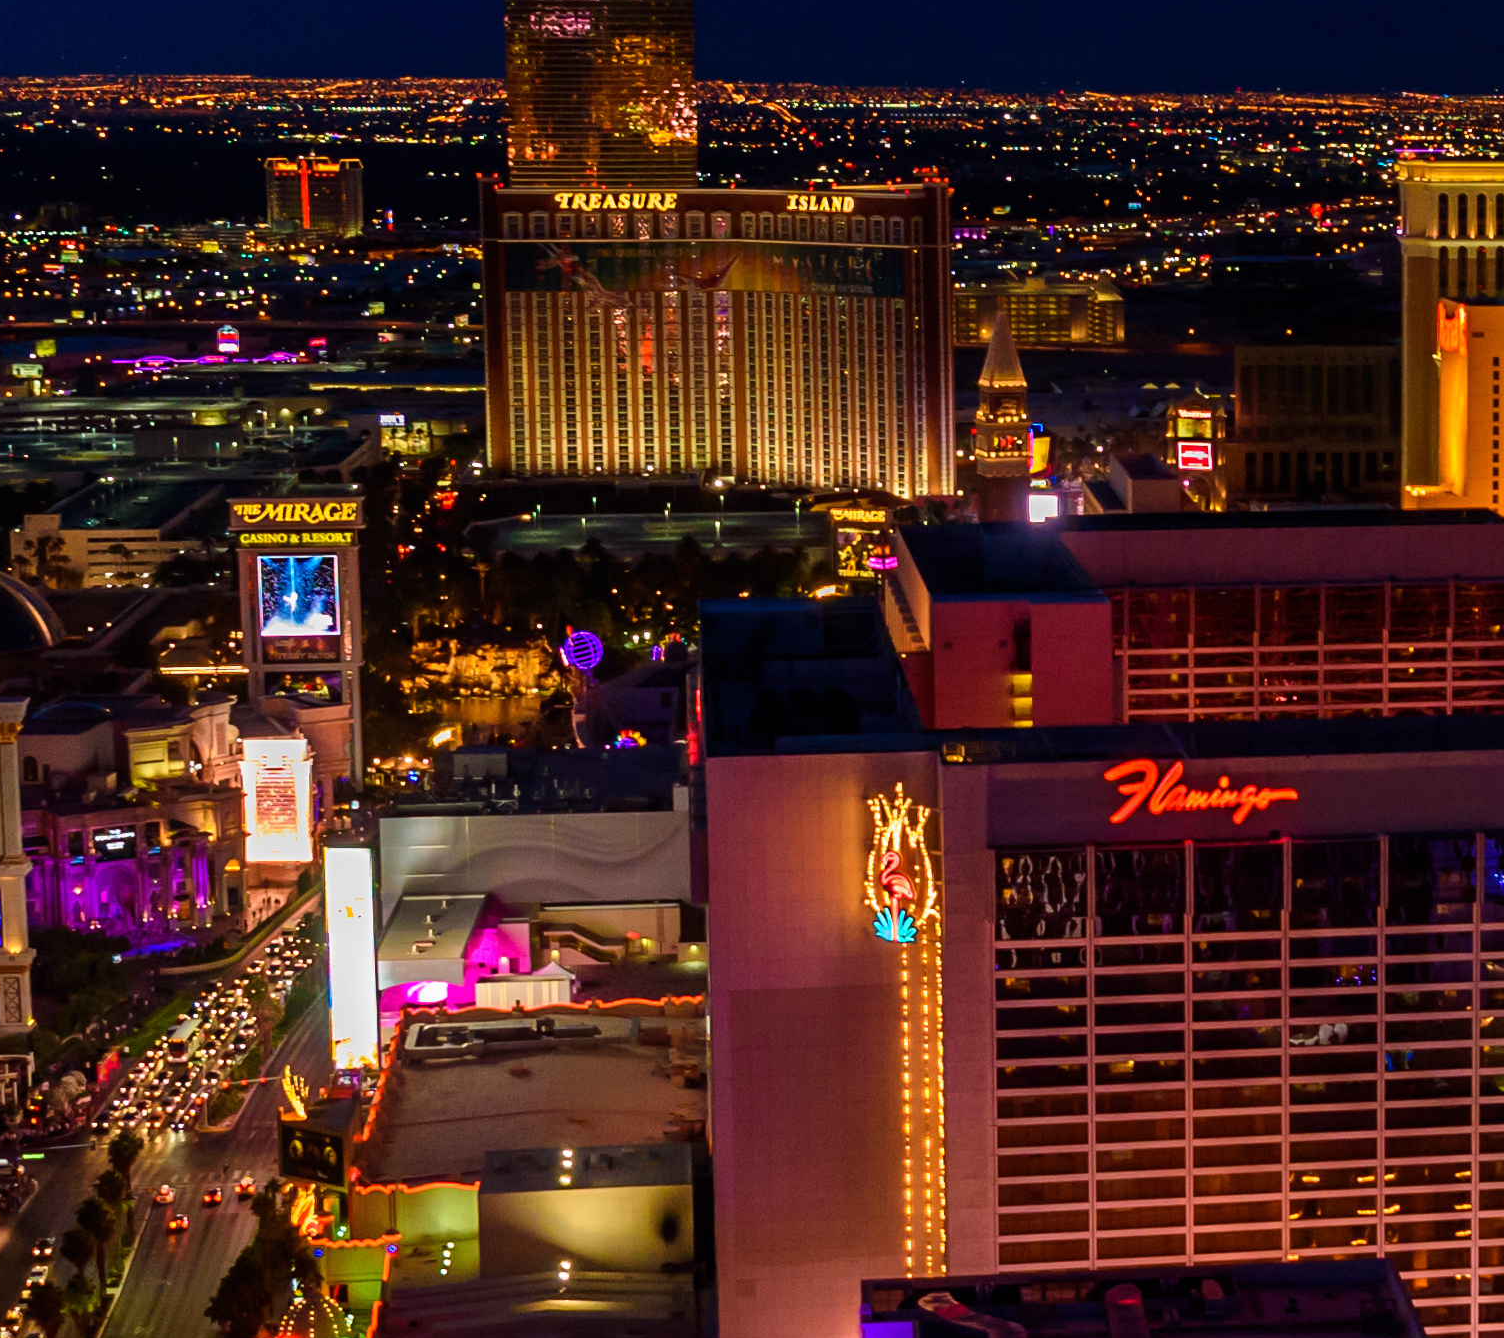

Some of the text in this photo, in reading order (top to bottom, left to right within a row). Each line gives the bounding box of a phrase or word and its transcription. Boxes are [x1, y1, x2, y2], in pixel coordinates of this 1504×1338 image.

[554, 193, 854, 212] TREASURE ISLAND
[234, 503, 357, 524] THE MIRAGE
[240, 533, 353, 543] CASINO & RESORT
[1104, 759, 1298, 825] Flamingo
